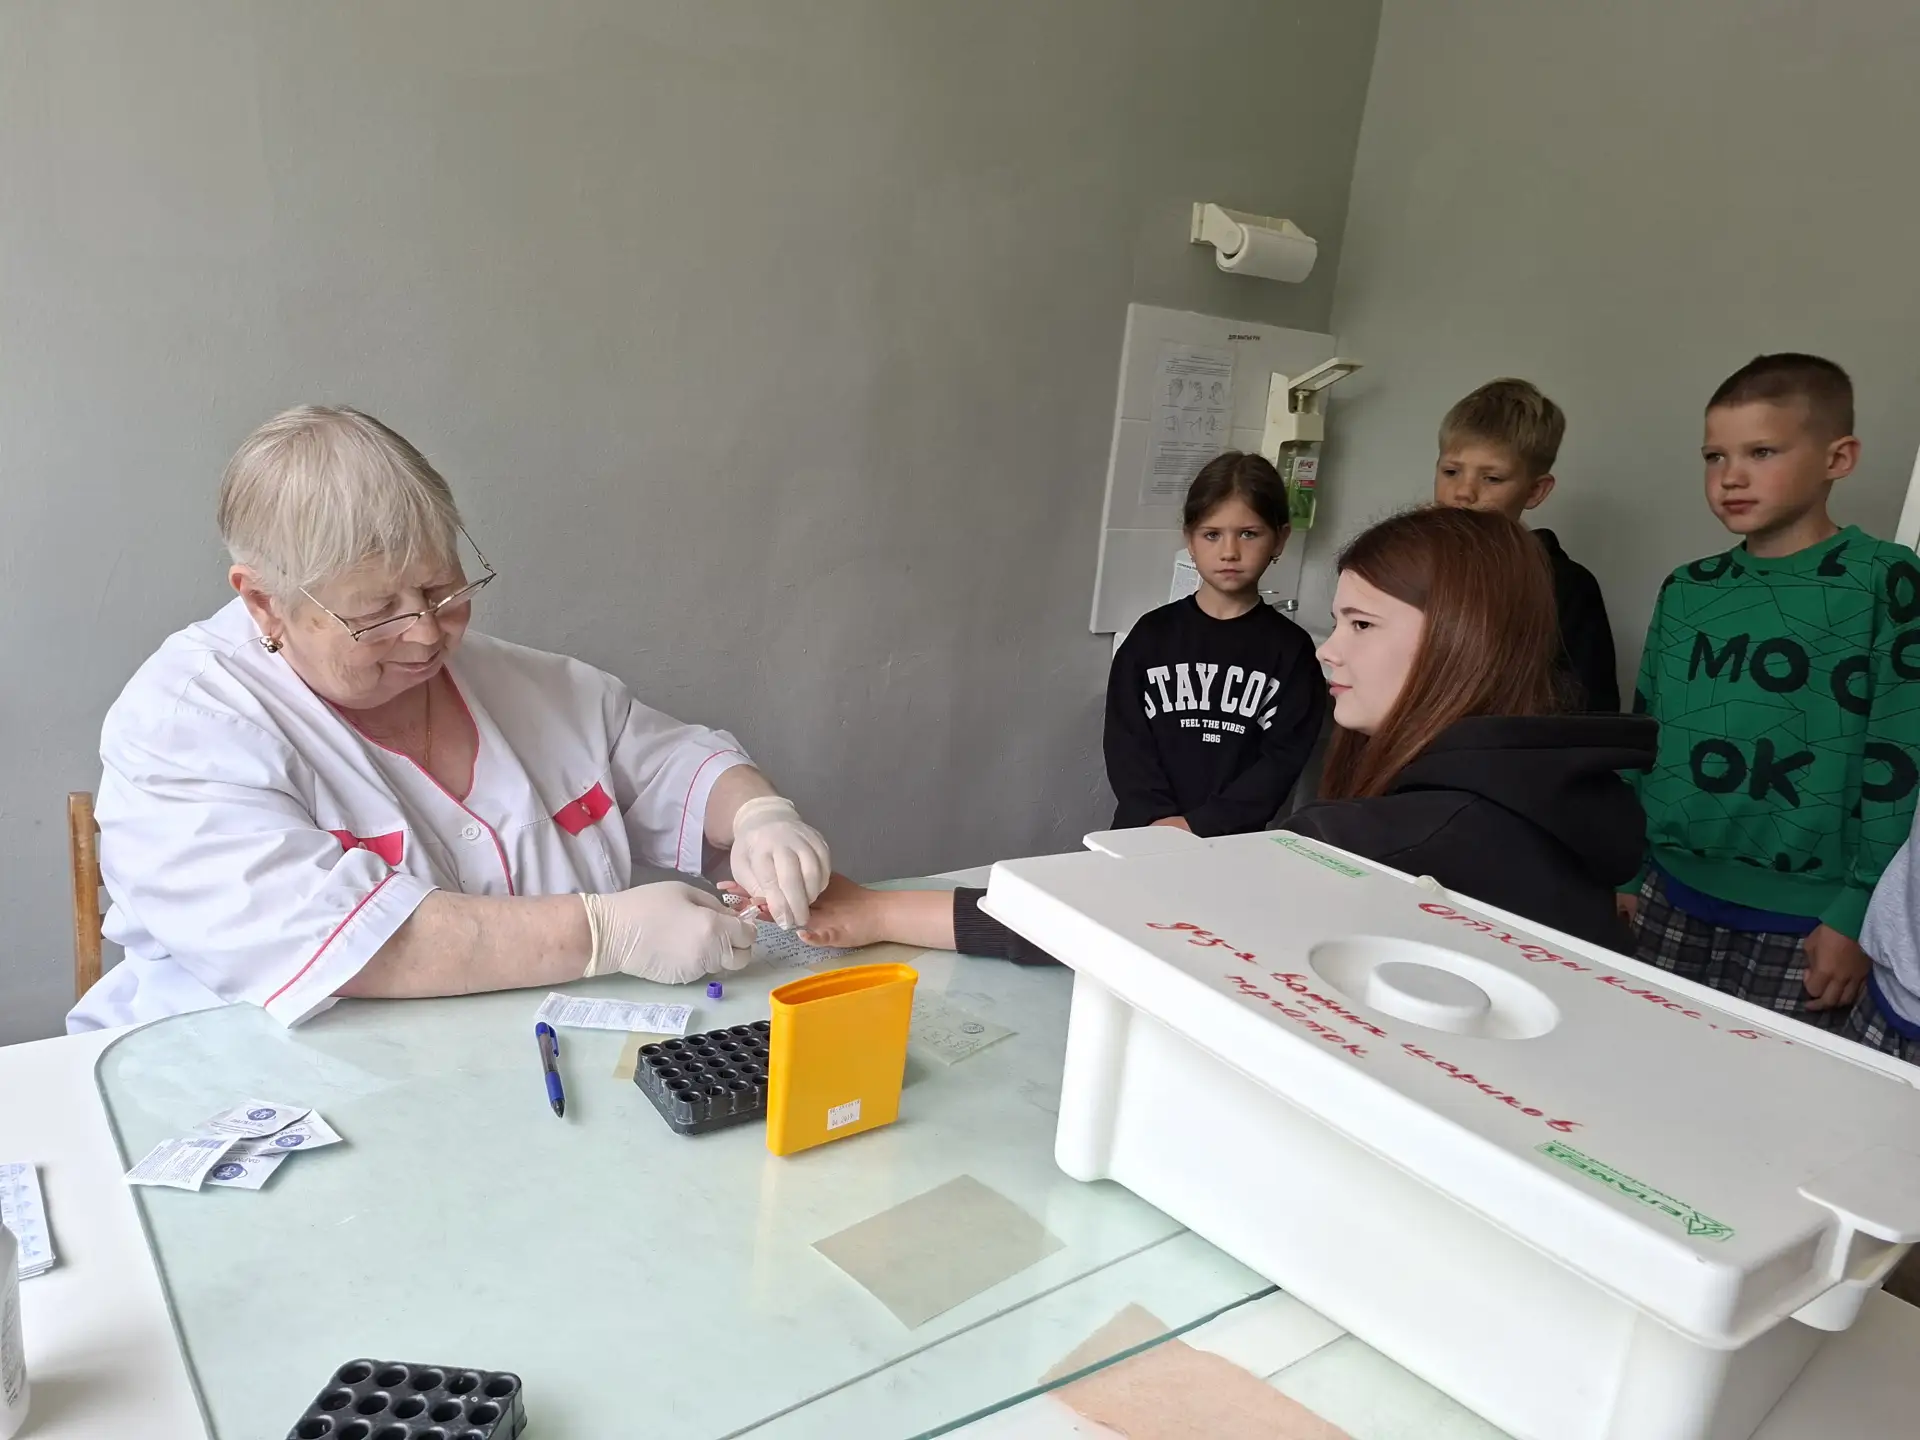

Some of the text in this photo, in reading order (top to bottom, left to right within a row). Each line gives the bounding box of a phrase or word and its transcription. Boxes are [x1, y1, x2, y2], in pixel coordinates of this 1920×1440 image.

[1180, 719, 1246, 735] FEEL THE VIBES
[1202, 733, 1221, 743] 1986
[1417, 902, 1592, 972] Отходы
[1545, 1146, 1683, 1217] ЕЛАМЕД
